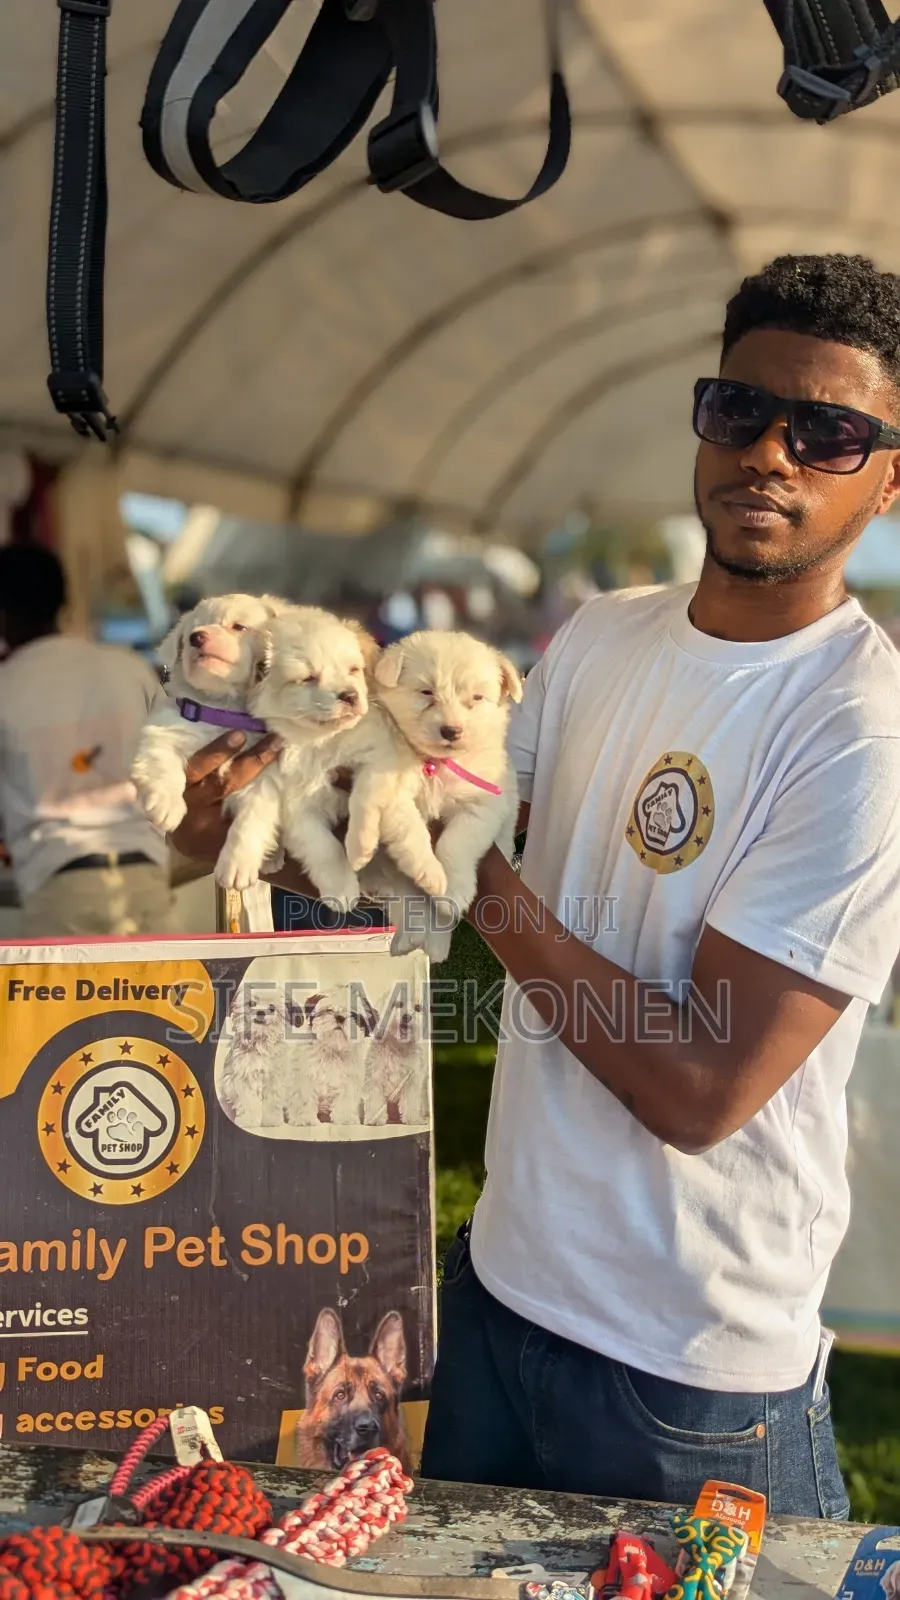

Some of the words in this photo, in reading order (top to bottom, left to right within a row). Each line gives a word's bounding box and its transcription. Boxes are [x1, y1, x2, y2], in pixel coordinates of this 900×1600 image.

[8, 979, 66, 1001] Free
[76, 978, 189, 1006] Delivery
[84, 1089, 126, 1129] FAMILY
[101, 1143, 117, 1153] PET
[119, 1143, 143, 1153] SHOP
[0, 1227, 127, 1281] amily
[144, 1225, 228, 1269] Pet
[240, 1222, 369, 1275] Shop
[17, 1354, 104, 1382] Food
[711, 1499, 751, 1521] D&H
[854, 1558, 886, 1571] D&H
